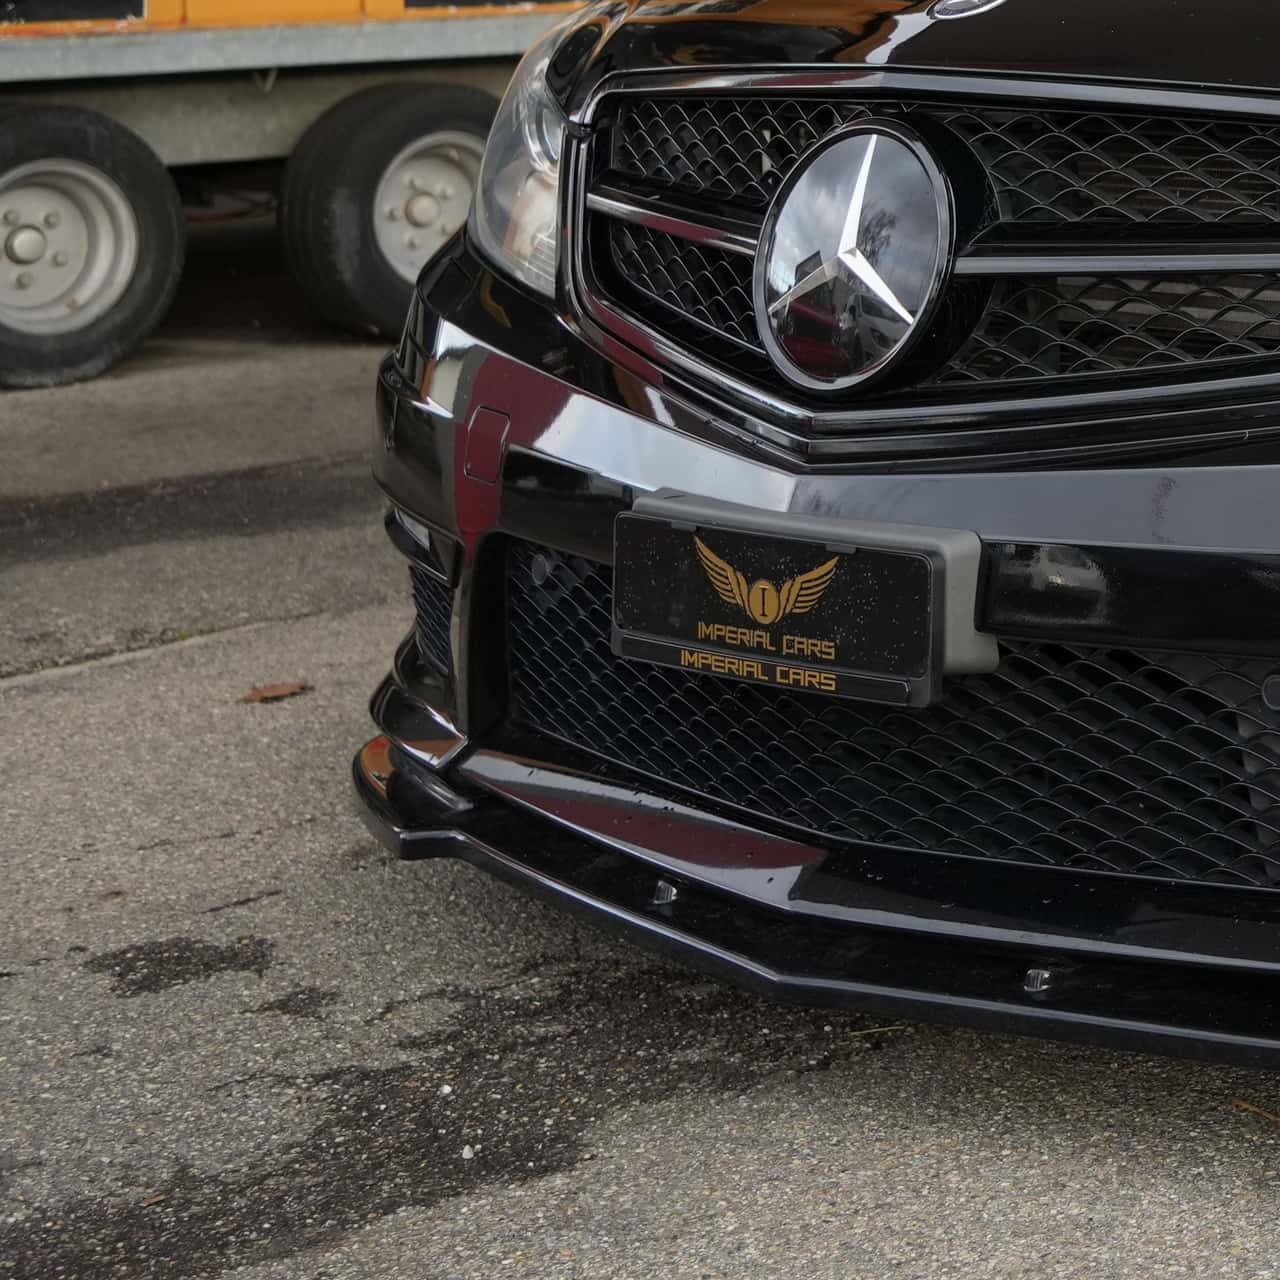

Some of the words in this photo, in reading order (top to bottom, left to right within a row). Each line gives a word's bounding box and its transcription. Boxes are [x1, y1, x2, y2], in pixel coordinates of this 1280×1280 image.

[697, 621, 777, 651] IMPERIAL
[782, 634, 835, 660] CARS
[680, 649, 769, 681] IMPERIAL
[775, 665, 837, 691] CARS
